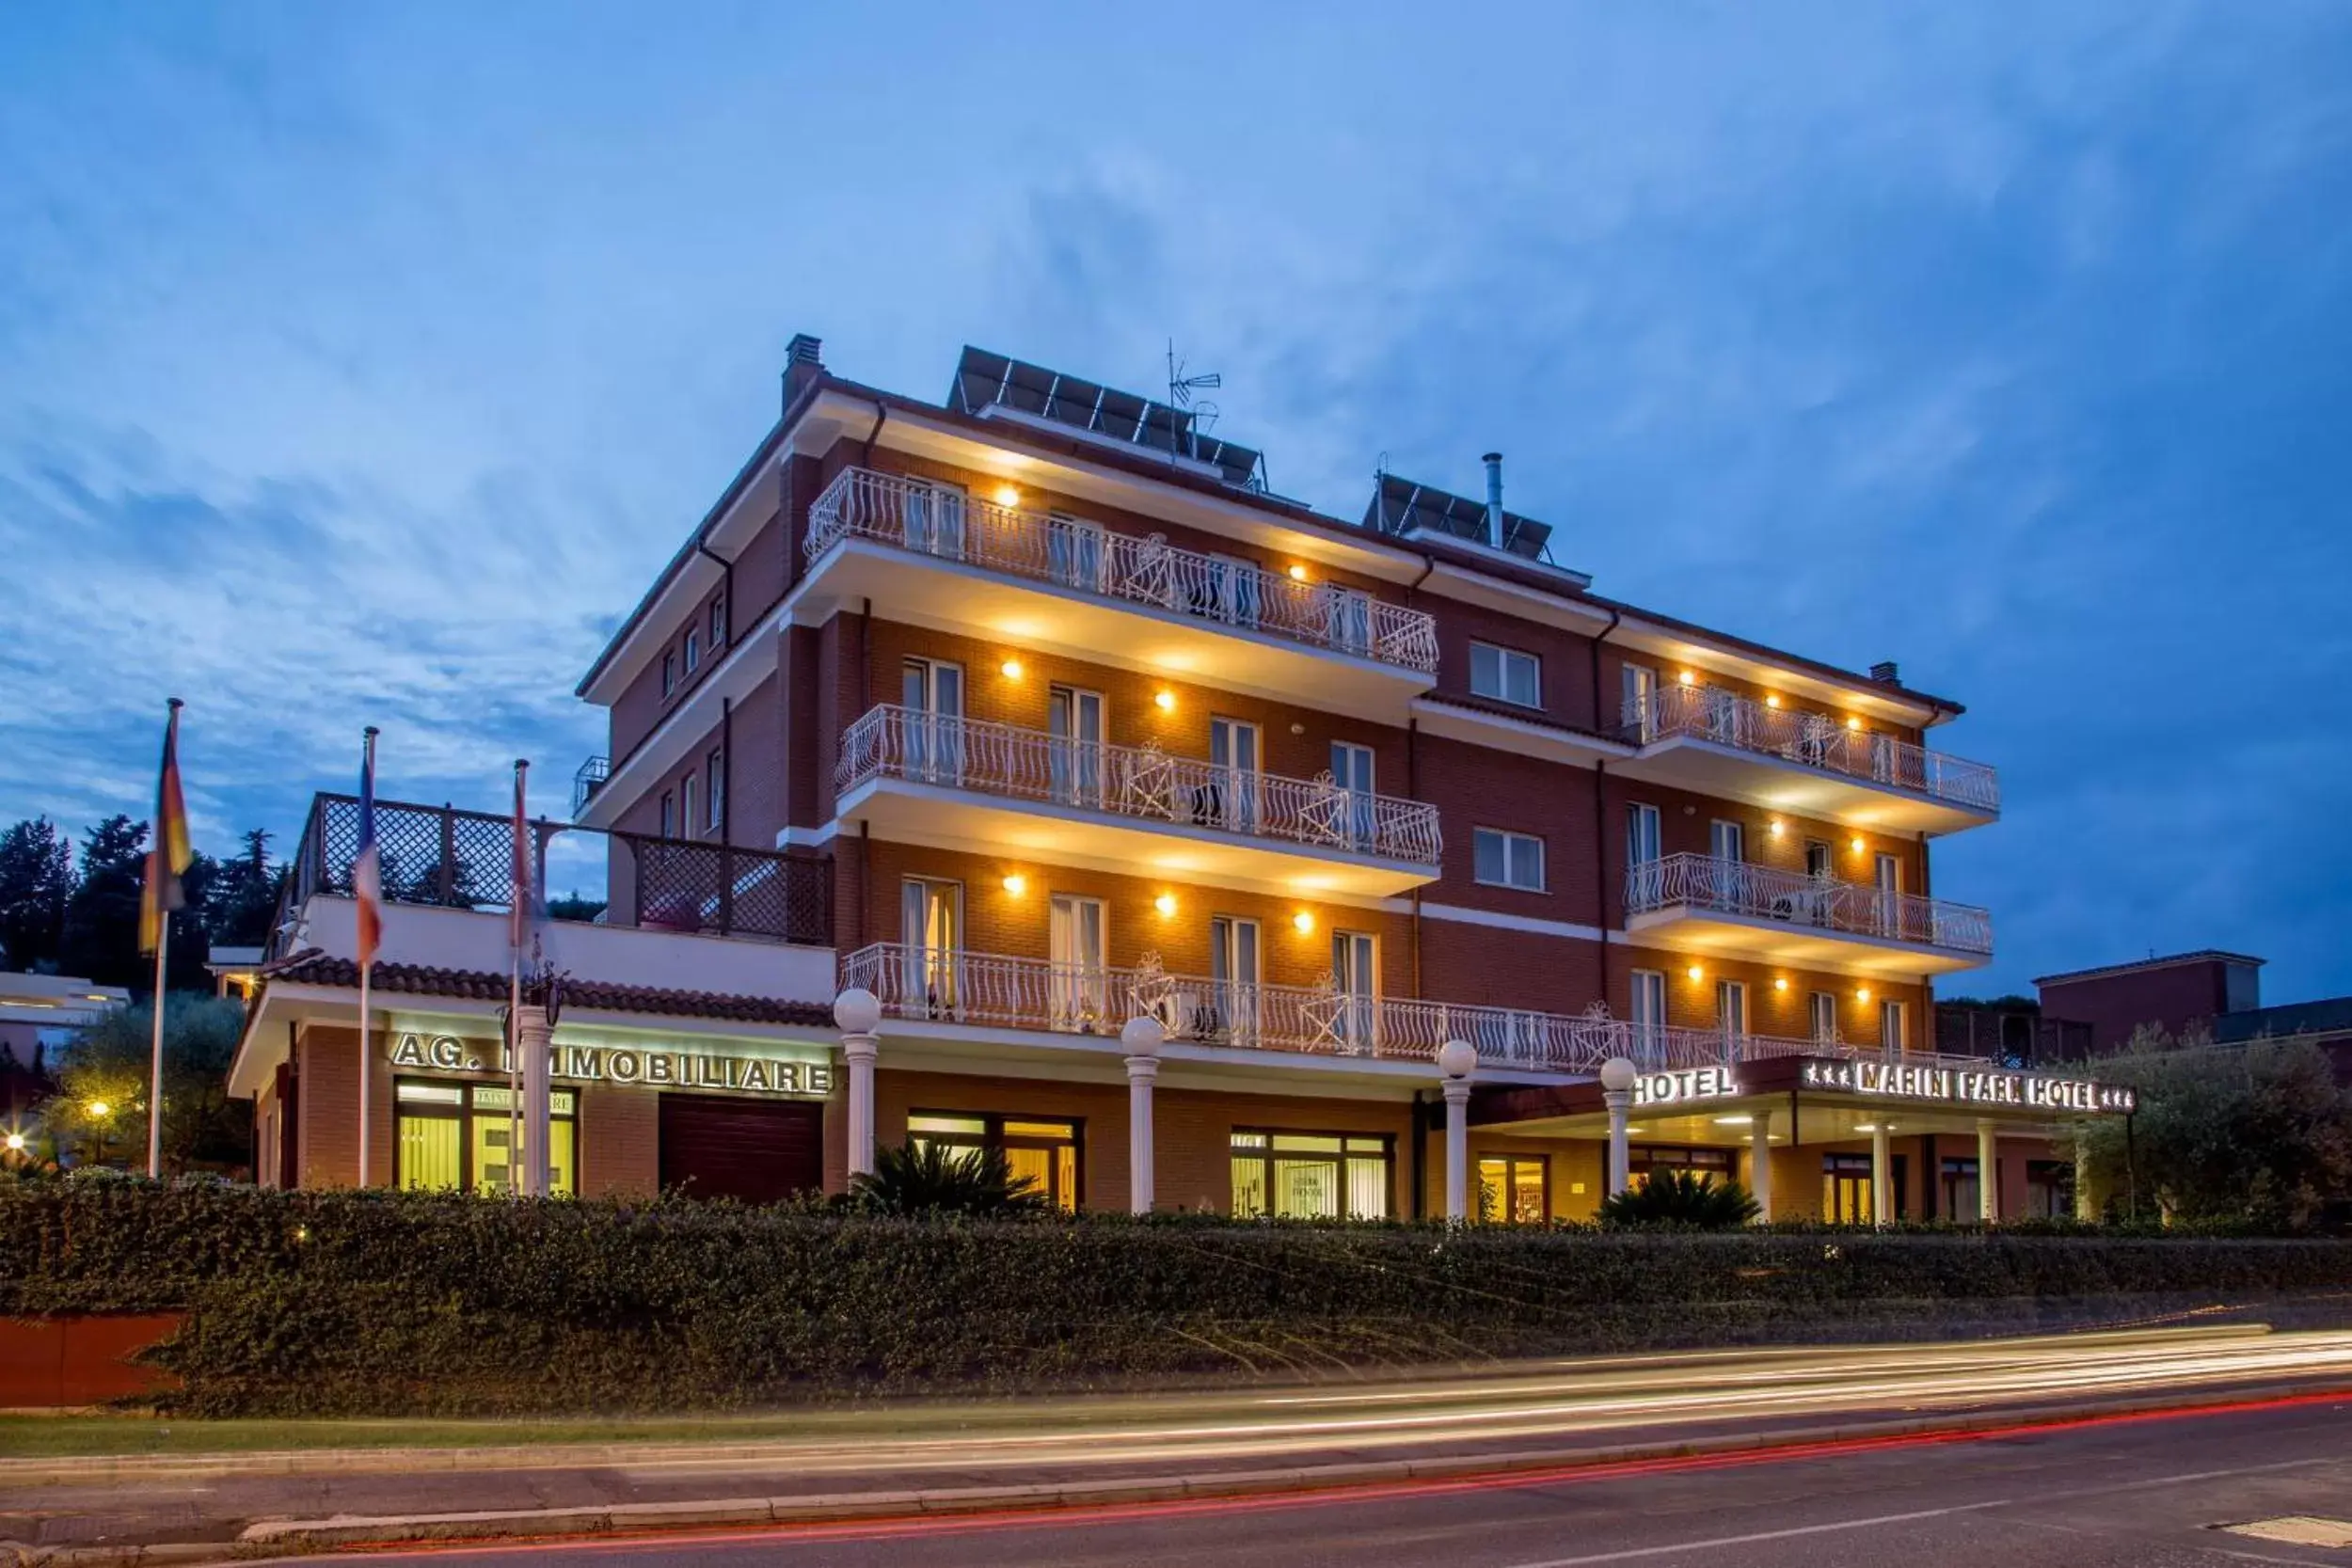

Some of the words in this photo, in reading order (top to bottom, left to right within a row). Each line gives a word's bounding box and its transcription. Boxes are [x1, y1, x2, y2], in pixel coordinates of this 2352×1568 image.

[393, 1033, 481, 1069] AG.
[1633, 1067, 1738, 1104] HOTEL
[1959, 1071, 2023, 1103] PARK
[2027, 1078, 2099, 1110] HOTEL
